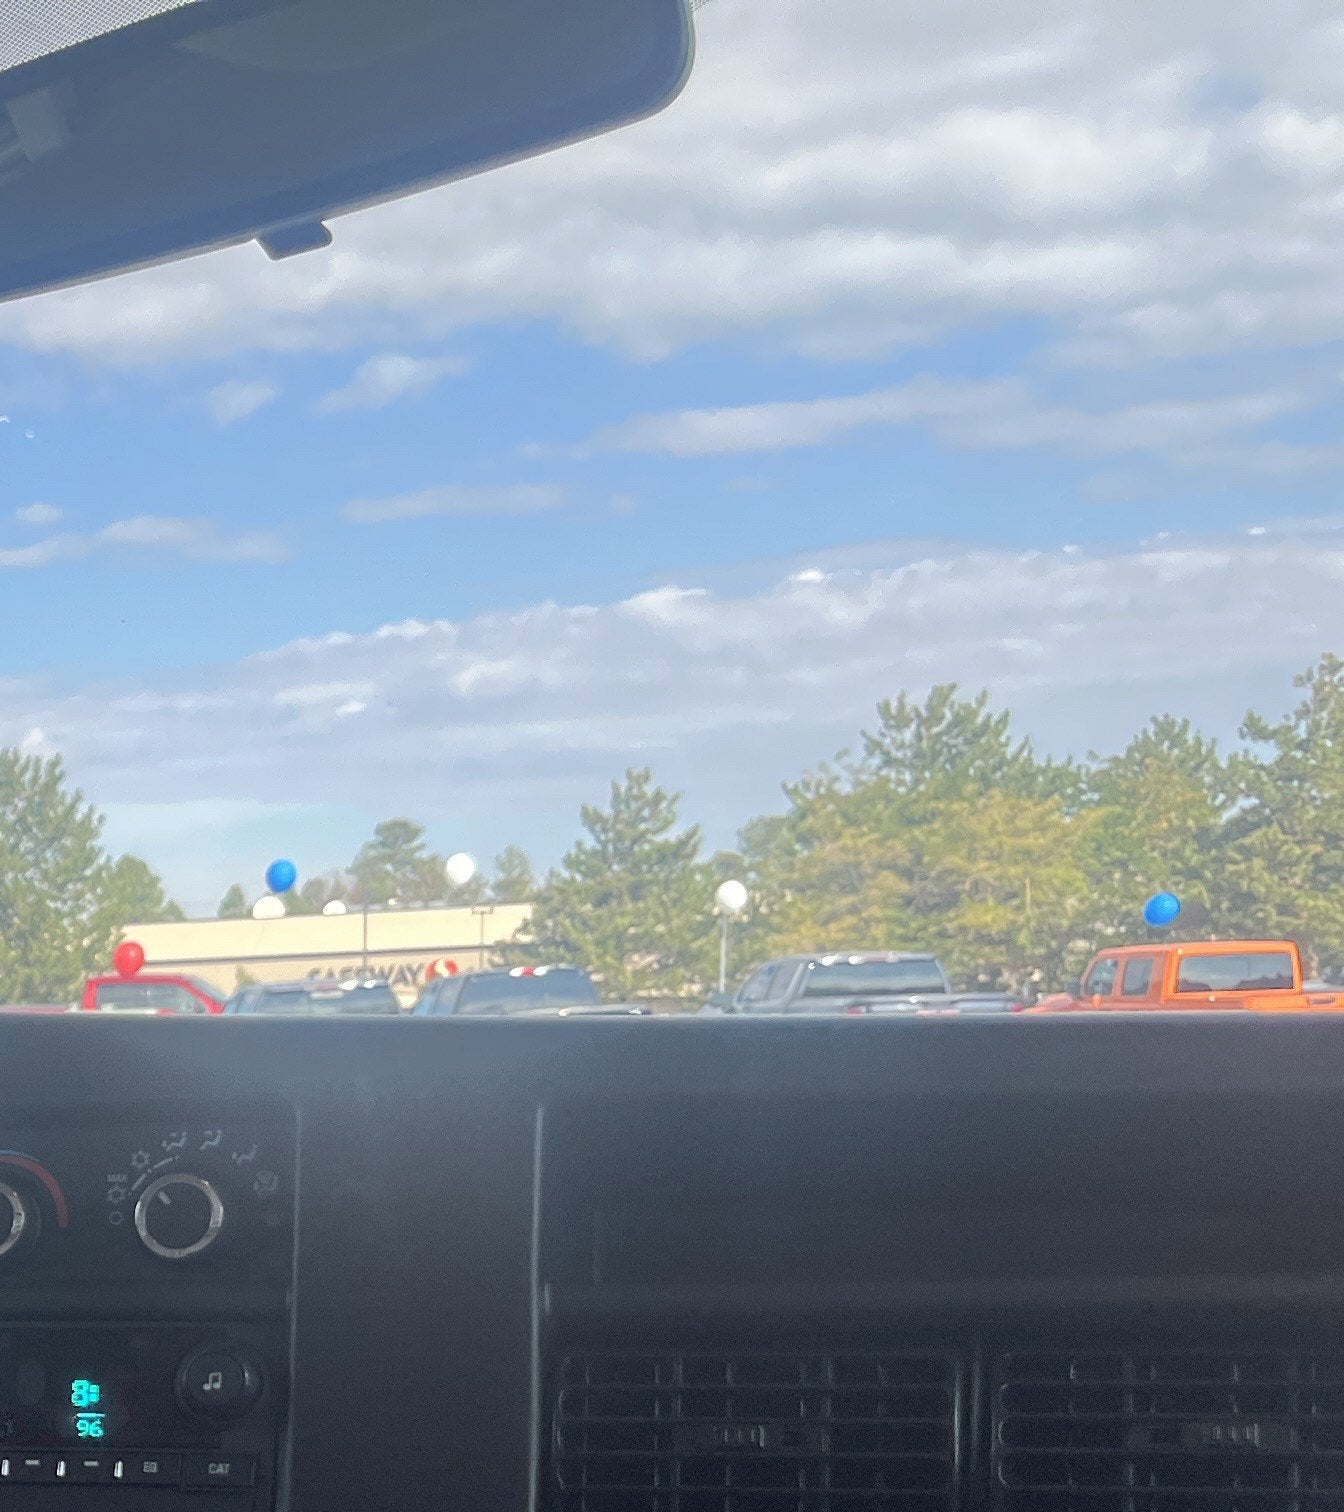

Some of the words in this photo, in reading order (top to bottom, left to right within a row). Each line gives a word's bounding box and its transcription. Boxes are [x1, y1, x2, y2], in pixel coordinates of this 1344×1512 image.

[107, 1174, 128, 1182] MAX
[76, 1418, 105, 1438] 96
[208, 1462, 231, 1475] CAT
